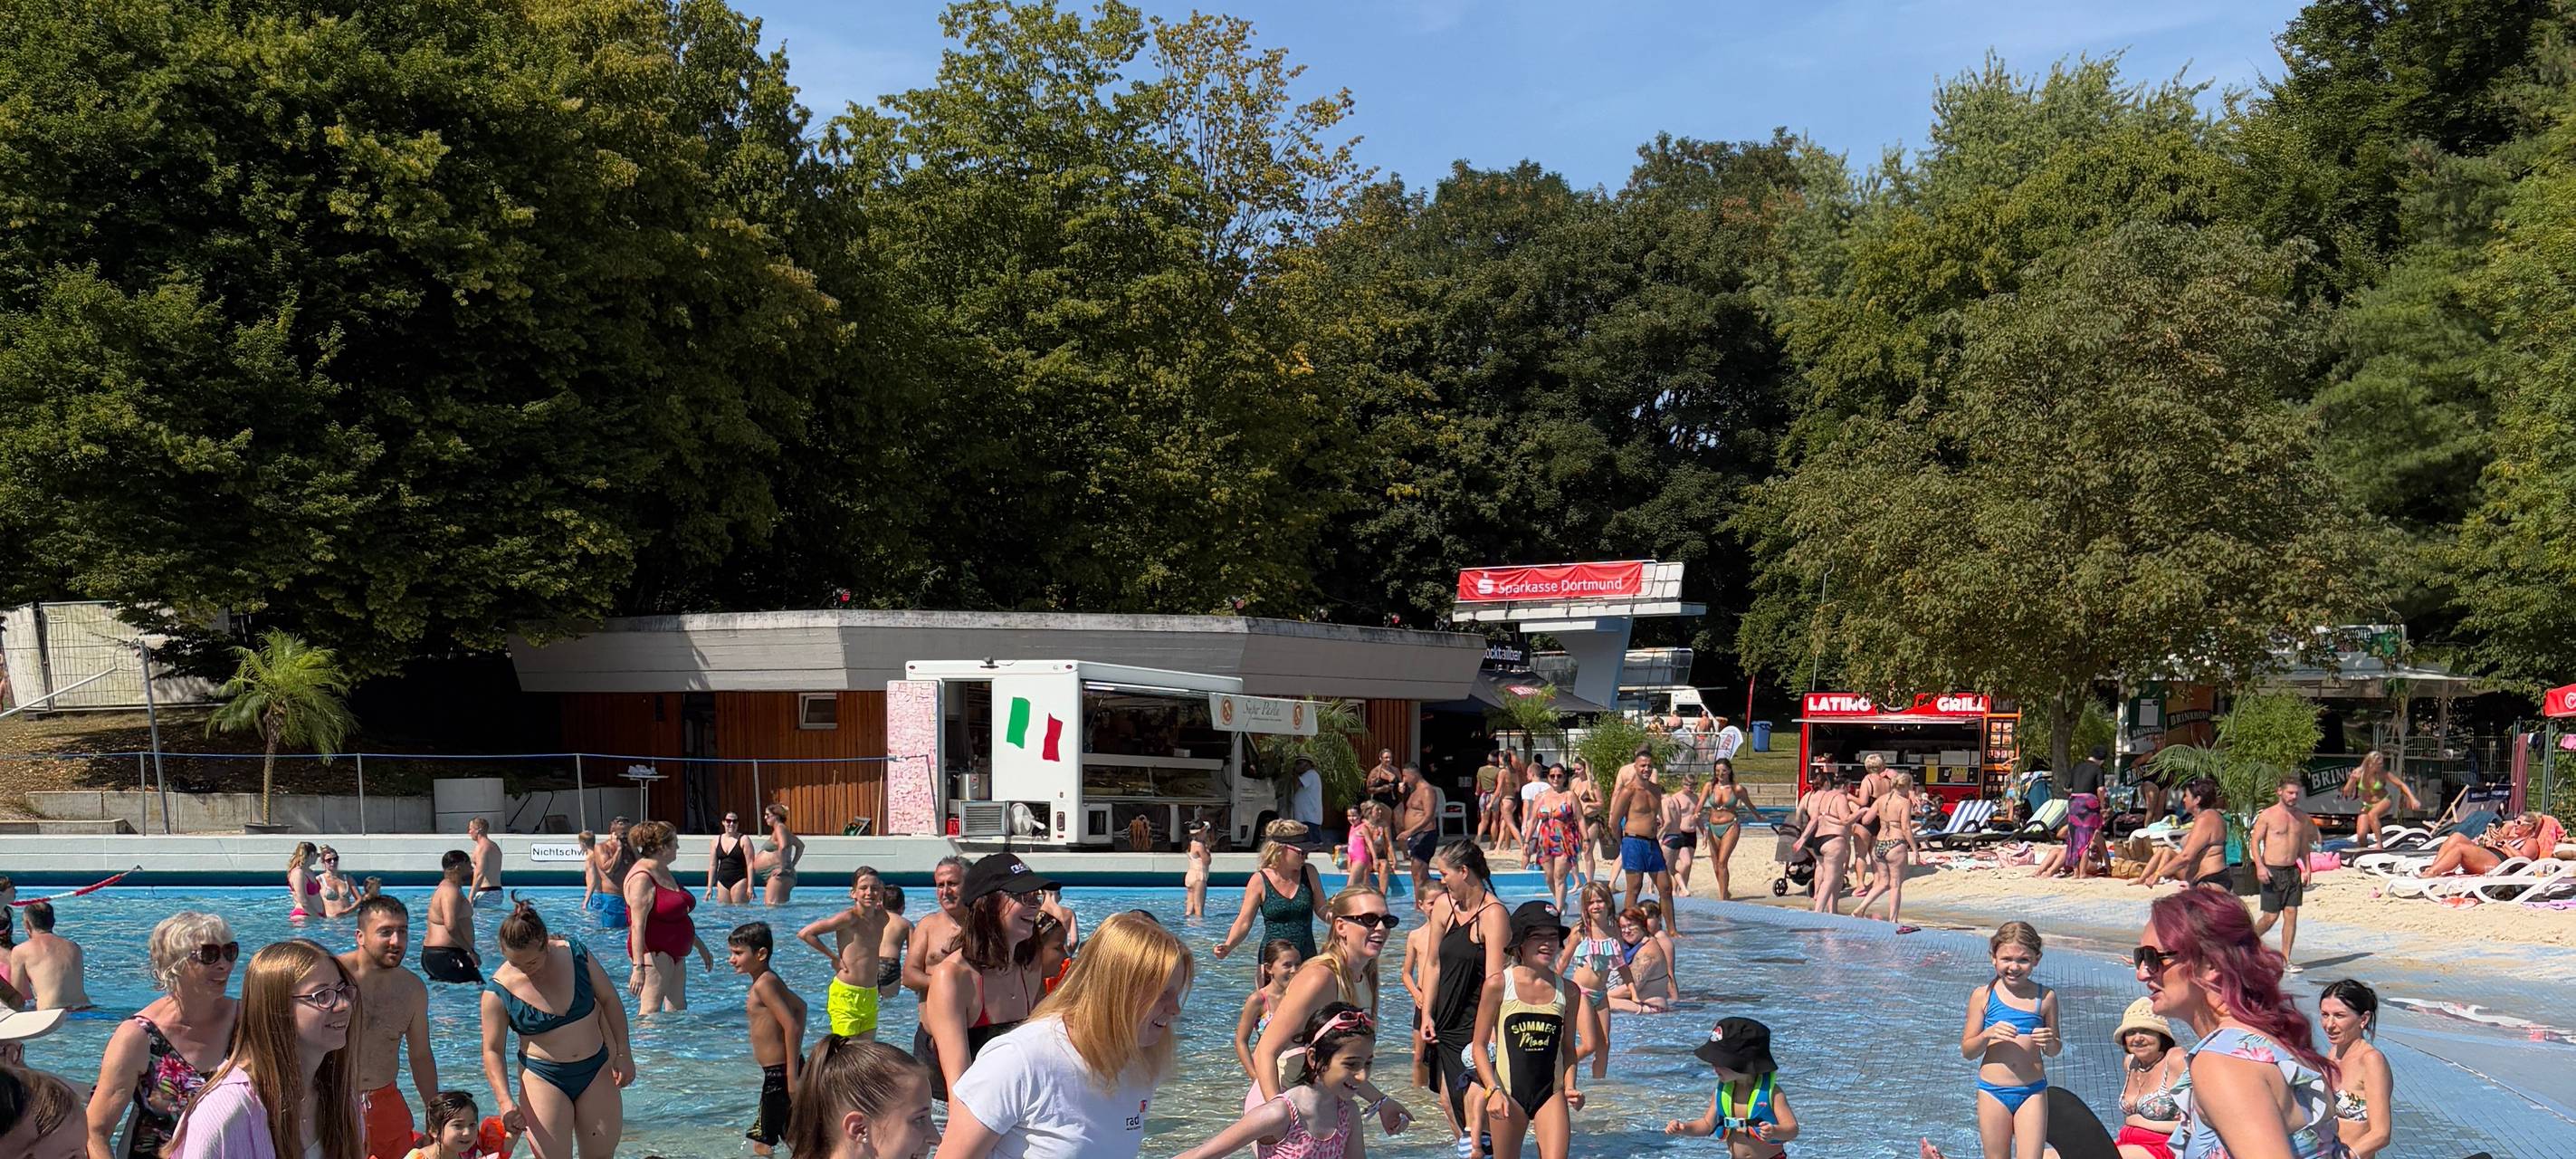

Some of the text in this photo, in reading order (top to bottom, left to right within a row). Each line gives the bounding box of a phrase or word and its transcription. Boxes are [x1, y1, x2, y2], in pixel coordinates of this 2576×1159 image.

[1498, 580, 1558, 595] Sparkasse
[1561, 578, 1623, 592] Dortmund
[1485, 644, 1522, 661] ocktailbar
[1808, 696, 1872, 712] LATINO
[1937, 696, 1986, 712] GRILL
[532, 848, 587, 856] Nichtschw
[1511, 1020, 1557, 1034] SUMMER
[1519, 1032, 1550, 1048] Mood
